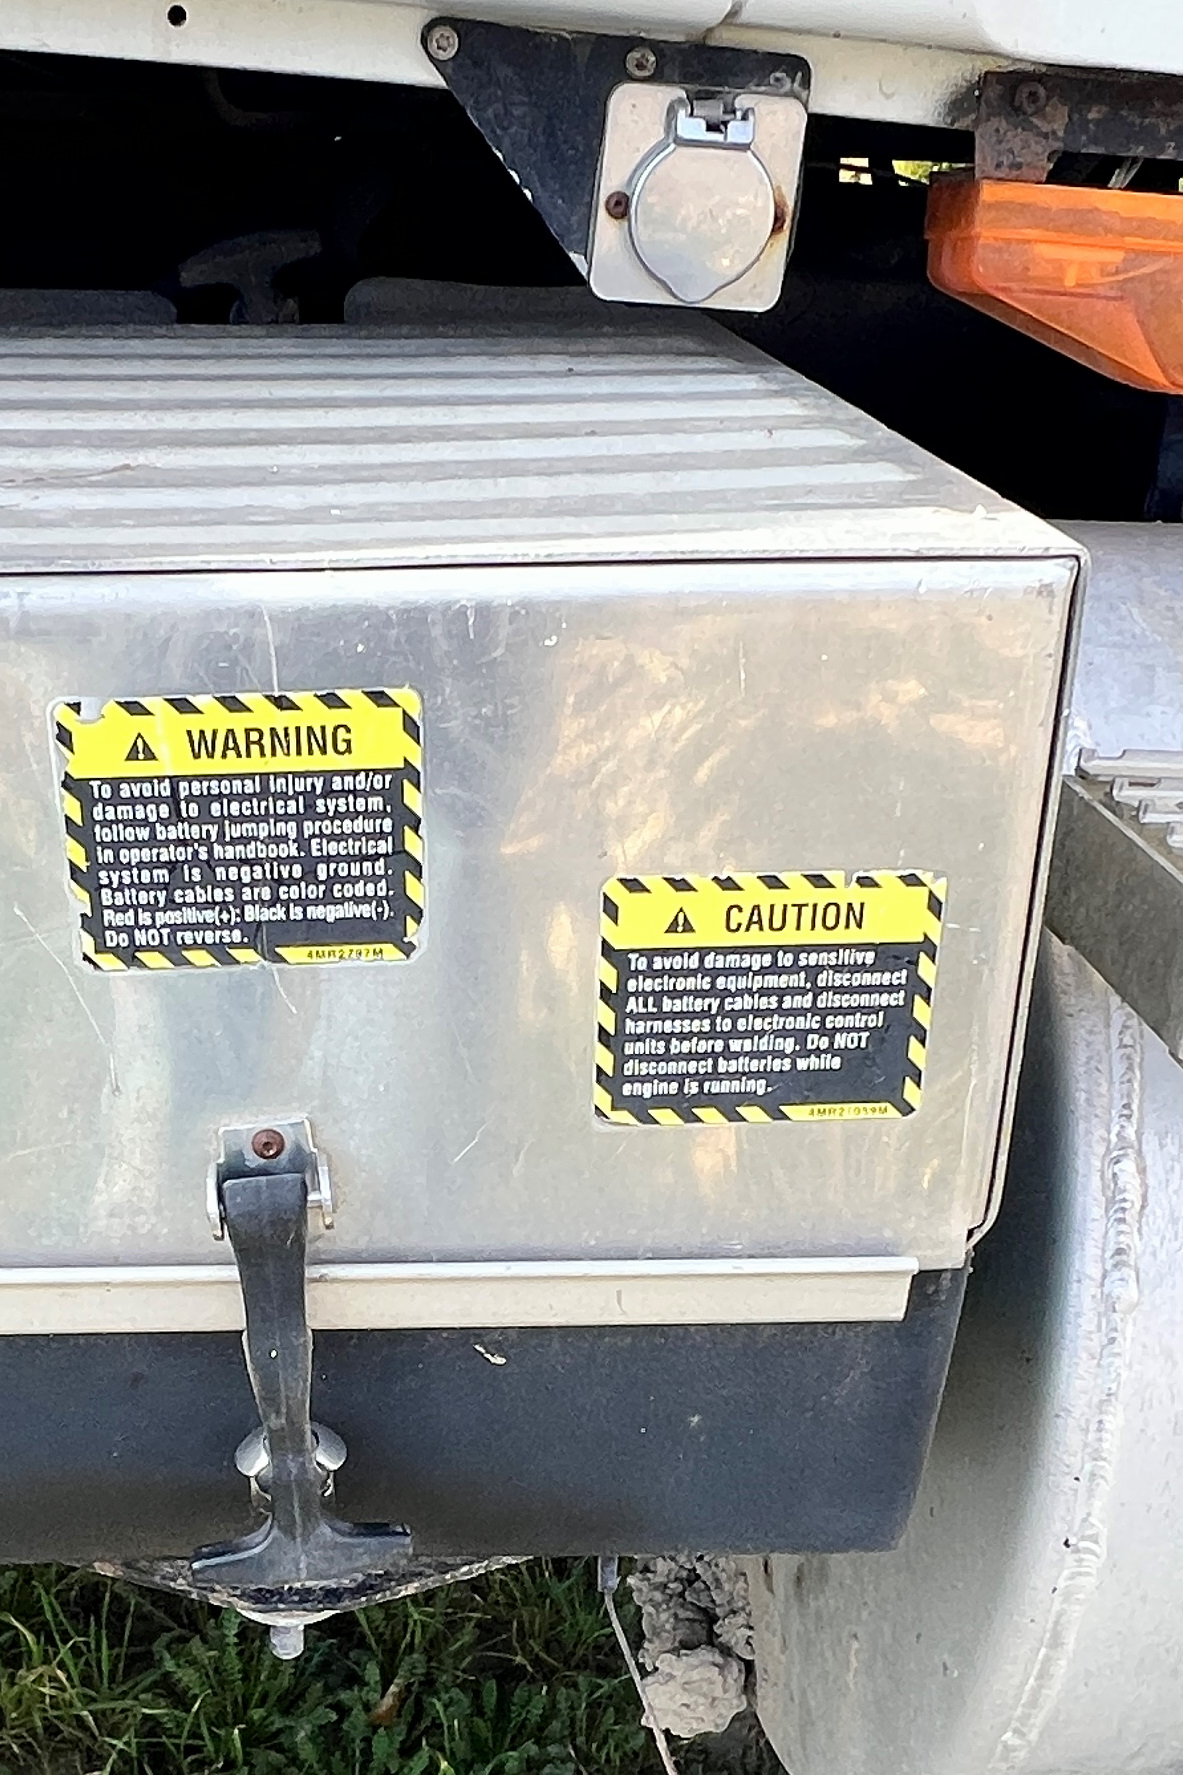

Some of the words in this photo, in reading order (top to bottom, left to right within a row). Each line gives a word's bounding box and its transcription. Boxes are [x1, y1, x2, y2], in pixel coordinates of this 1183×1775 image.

[186, 724, 353, 760] WARNING
[89, 780, 112, 798] To
[119, 778, 171, 798] avoid
[179, 775, 261, 799] personal
[269, 773, 324, 795] injury
[332, 771, 392, 791] and/or
[92, 802, 170, 822] damage
[180, 800, 199, 818] to
[210, 795, 304, 818] electrical
[94, 823, 150, 842] follow
[155, 821, 218, 842] battery
[225, 818, 297, 841] jumping
[303, 815, 393, 838] procedure
[96, 845, 114, 864] in
[119, 843, 208, 866] operator's
[214, 840, 306, 860] handbook.
[311, 836, 392, 856] Electrical
[98, 867, 169, 888] system
[183, 864, 201, 882] is
[215, 861, 302, 884] negative
[317, 857, 393, 881] ground.
[101, 888, 166, 907] Battery
[173, 885, 234, 903] cables
[242, 886, 271, 901] are
[279, 881, 326, 899] color
[332, 878, 394, 898] coded.
[103, 908, 135, 927] Red
[138, 908, 152, 926] is
[244, 903, 286, 921] Black
[289, 903, 303, 920] is
[725, 902, 865, 933] CAUTION
[104, 930, 129, 947] Do
[134, 928, 170, 946] NOT
[177, 928, 249, 945] reverse.
[628, 953, 647, 971] To
[652, 952, 700, 970] avoid
[704, 952, 772, 971] damage
[777, 950, 794, 967] to
[798, 949, 875, 967] sensitive
[627, 973, 712, 992] electronic
[716, 970, 811, 993] equipment,
[817, 969, 907, 987] disconnect
[625, 996, 657, 1014] ALL
[662, 995, 720, 1014] battery
[724, 993, 778, 1011] cables
[782, 992, 813, 1009] and
[817, 990, 905, 1008] disconnect
[625, 1018, 710, 1034] harnesses
[716, 1016, 732, 1032] to
[736, 1013, 821, 1031] electronic
[825, 1011, 884, 1028] control
[624, 1038, 665, 1055] units
[670, 1037, 724, 1054] before
[729, 1034, 800, 1054] welding.
[806, 1033, 829, 1050] Do
[834, 1031, 870, 1049] NOT
[623, 1058, 713, 1076] disconnect
[718, 1055, 792, 1073] batteries
[796, 1053, 841, 1071] while
[622, 1079, 679, 1098] engine
[683, 1078, 699, 1094] is
[703, 1076, 772, 1096] running.
